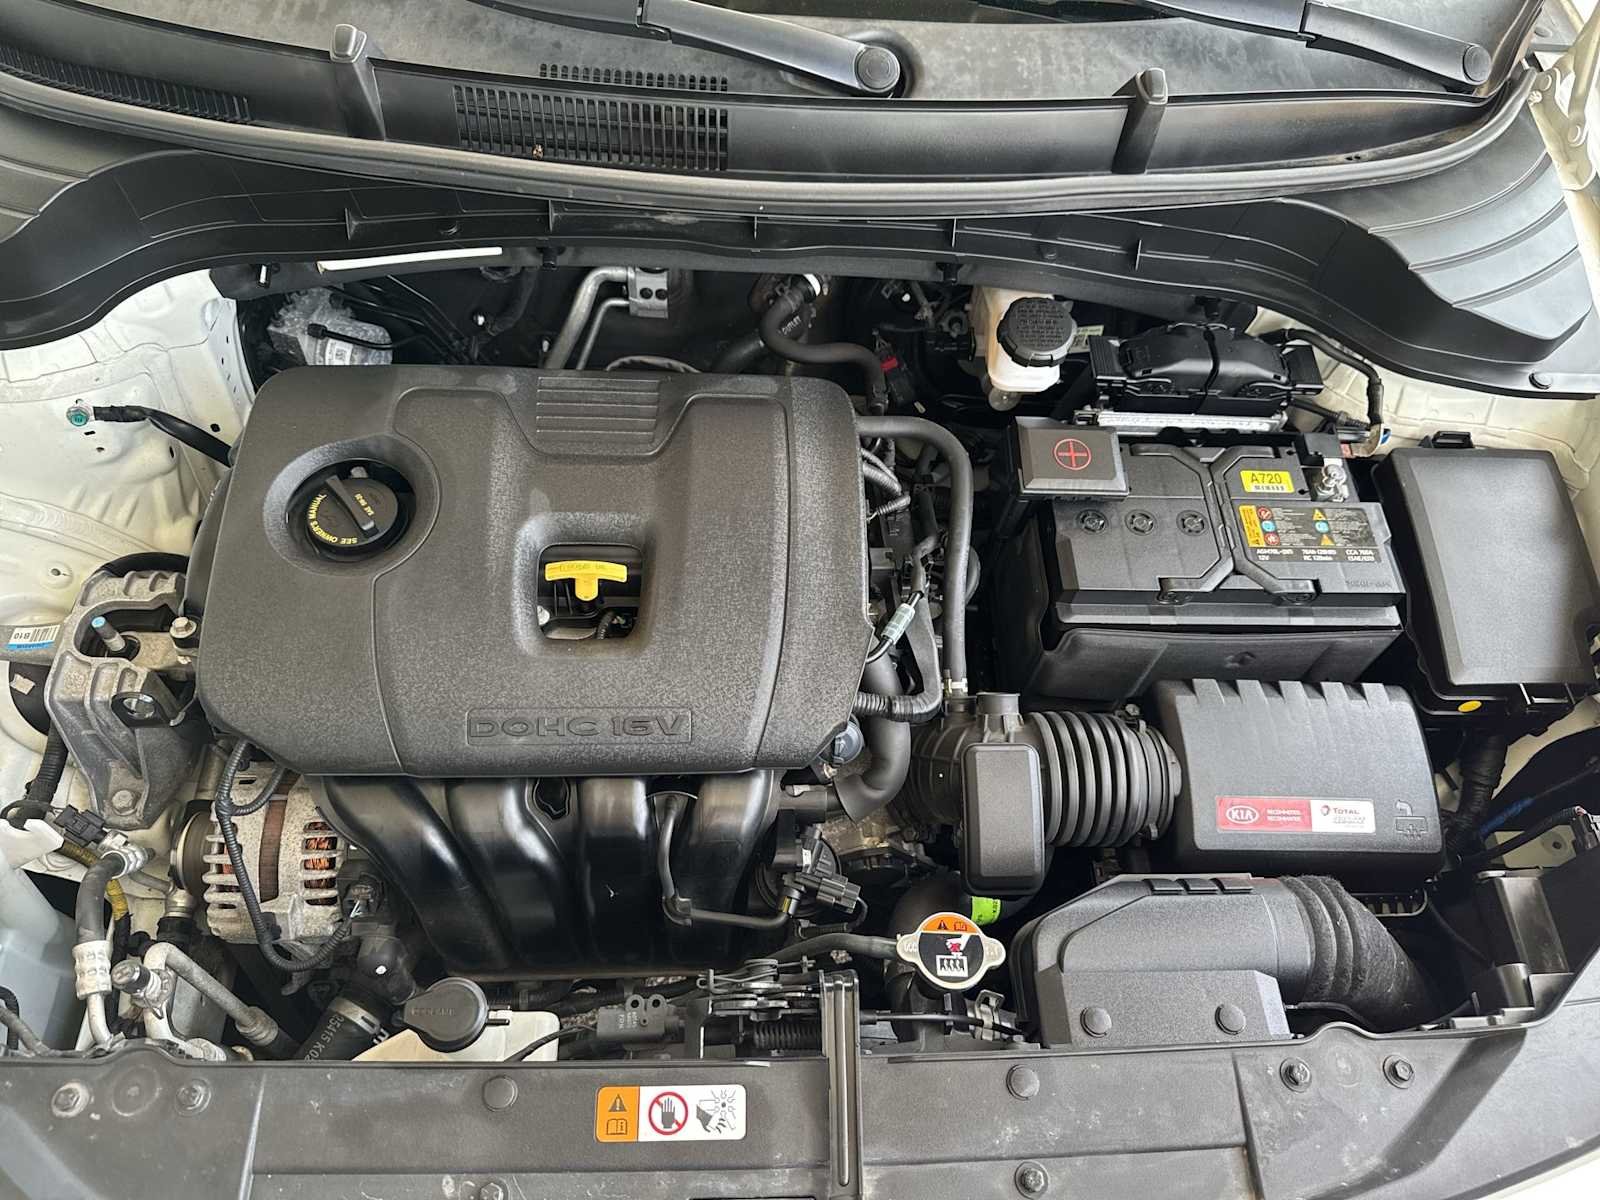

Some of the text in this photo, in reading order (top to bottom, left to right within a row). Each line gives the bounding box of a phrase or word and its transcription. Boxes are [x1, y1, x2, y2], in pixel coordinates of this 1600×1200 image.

[1250, 472, 1283, 484] A720
[308, 493, 358, 545] SEE OWNER'S MANUAL
[469, 715, 687, 738] DOHC 16V
[1230, 809, 1254, 821] KIA
[1332, 807, 1361, 815] TOTAL
